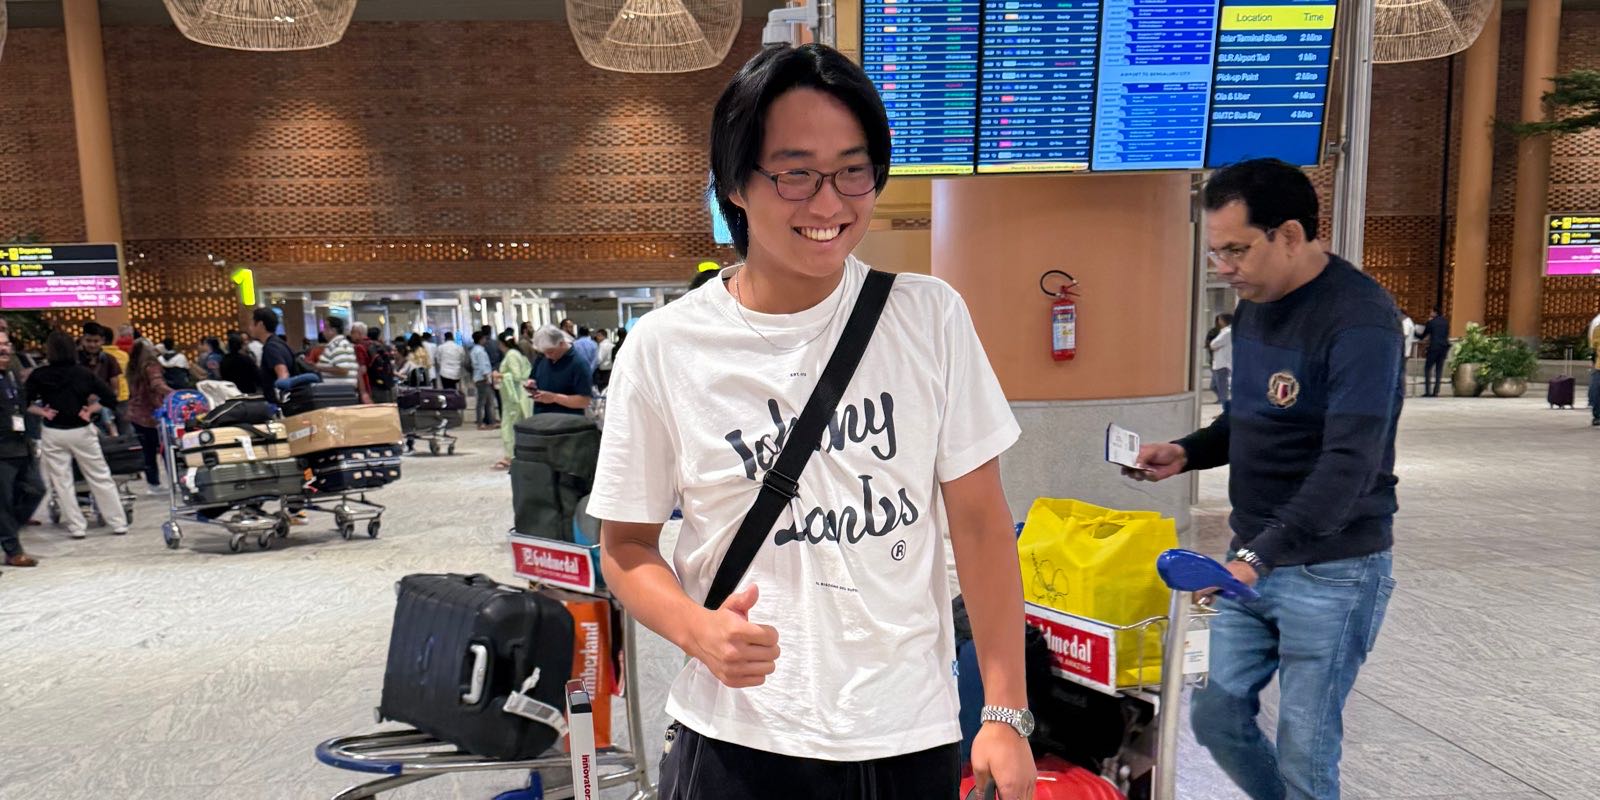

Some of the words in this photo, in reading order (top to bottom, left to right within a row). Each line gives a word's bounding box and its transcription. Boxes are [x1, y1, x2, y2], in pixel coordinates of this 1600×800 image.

[1236, 13, 1273, 22] Location
[1303, 12, 1324, 21] Time
[1236, 34, 1264, 42] Terminal
[1264, 33, 1288, 42] Shuttle
[1299, 33, 1307, 42] 2
[1232, 53, 1256, 63] Airport
[1256, 53, 1270, 62] Taxi
[1297, 53, 1303, 61] 1
[1241, 73, 1259, 82] Point
[1295, 72, 1302, 80] 2
[1290, 111, 1298, 119] 4
[18, 247, 52, 255] Departures
[231, 268, 256, 306] 1
[533, 549, 580, 574] Goldmedal
[581, 754, 592, 800] innovator
